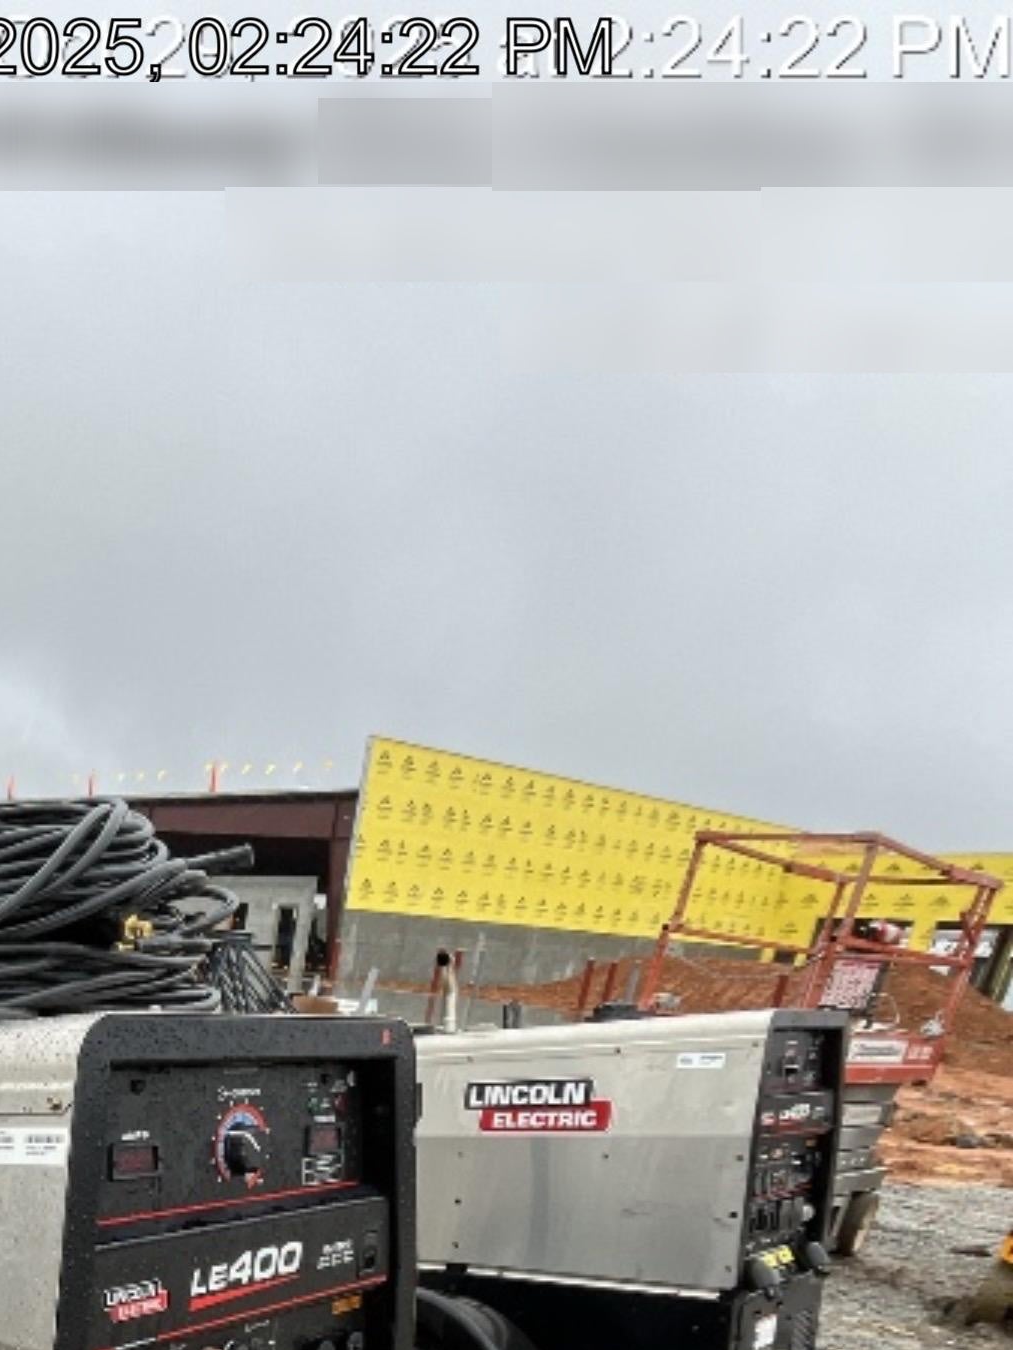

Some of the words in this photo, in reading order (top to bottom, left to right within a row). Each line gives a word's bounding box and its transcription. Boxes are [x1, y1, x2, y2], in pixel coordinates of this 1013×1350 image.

[469, 1082, 587, 1108] LINCOLN
[492, 1111, 598, 1129] ELECTRIC
[190, 1241, 303, 1297] LE400
